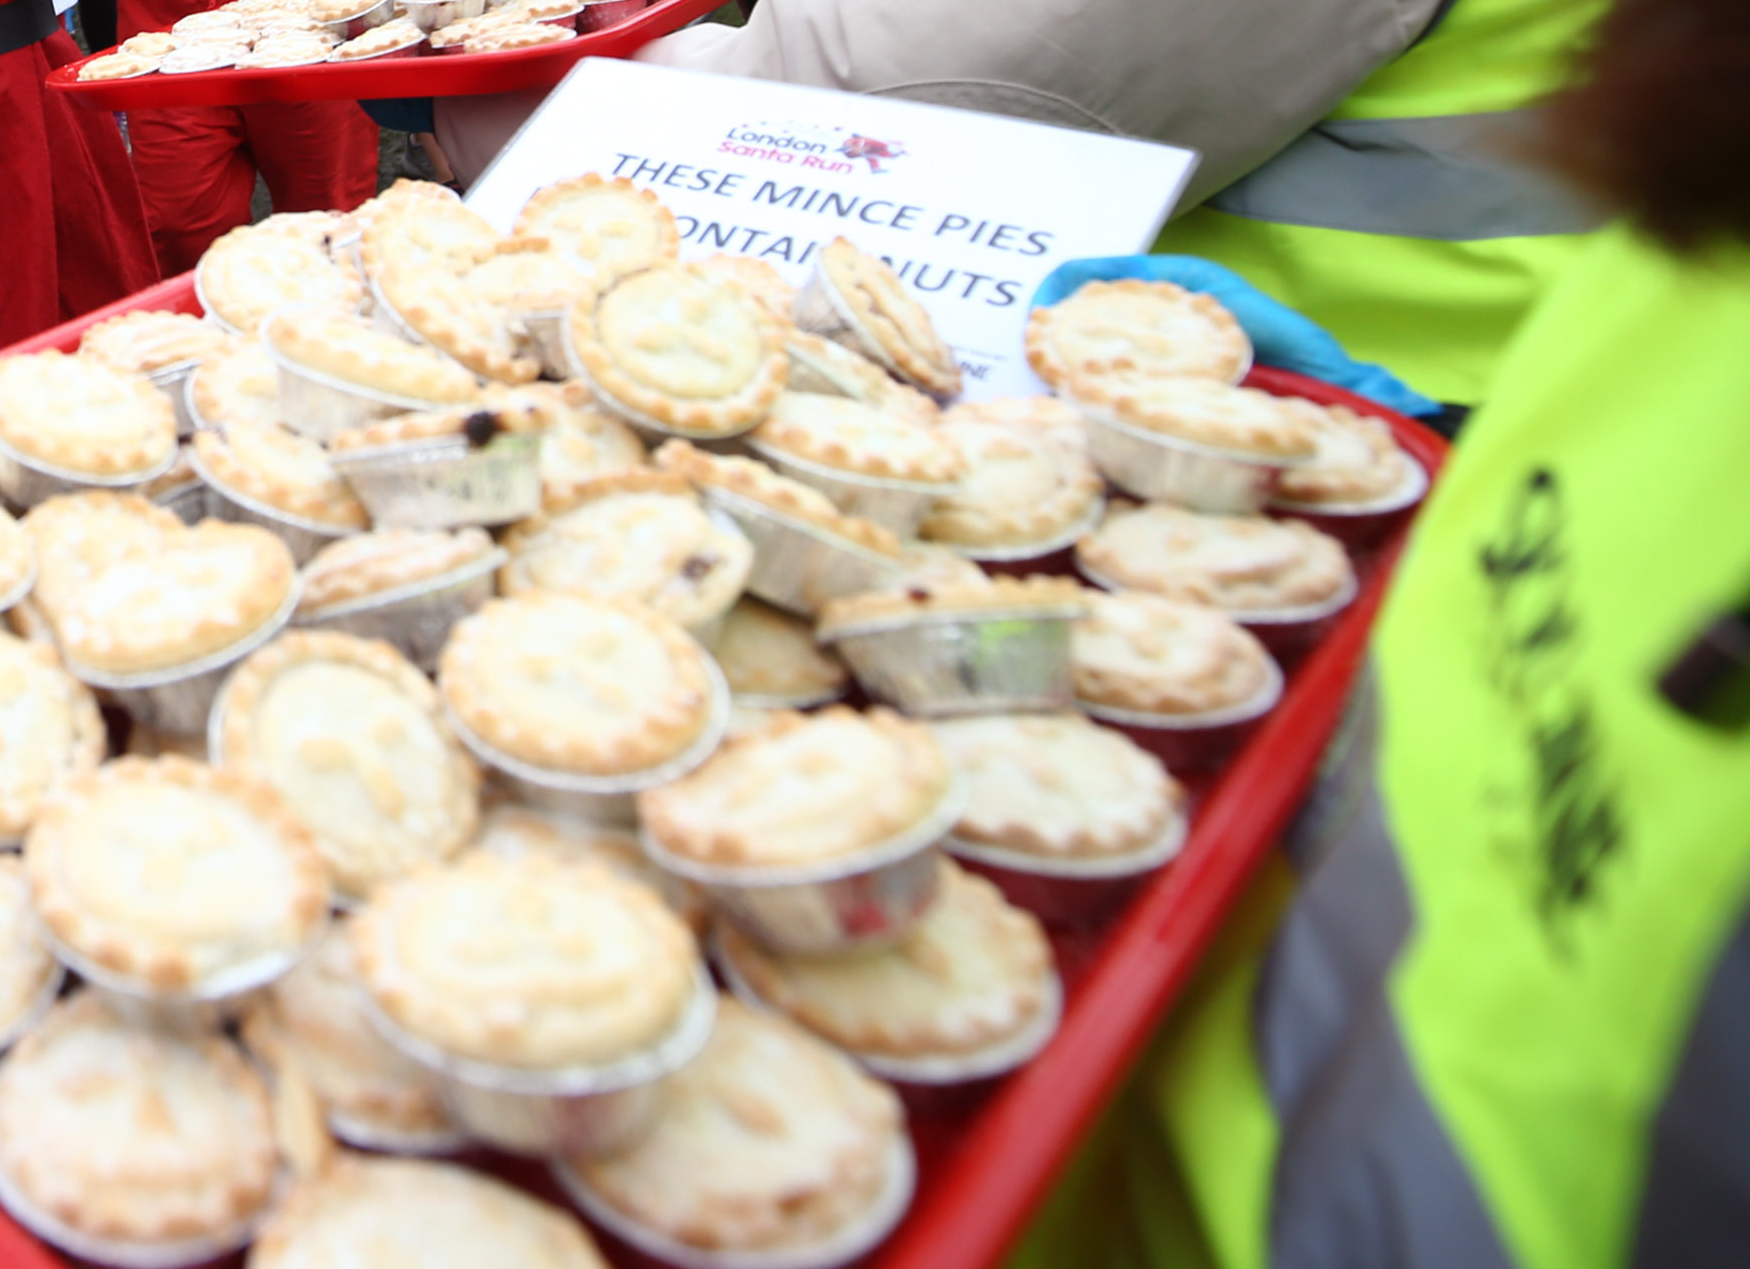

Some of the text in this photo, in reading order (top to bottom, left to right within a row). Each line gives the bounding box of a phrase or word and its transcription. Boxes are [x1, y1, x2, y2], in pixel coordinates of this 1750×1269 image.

[716, 140, 854, 175] Santa Run
[725, 127, 828, 154] London
[611, 152, 1056, 257] THESE MINCE PIES
